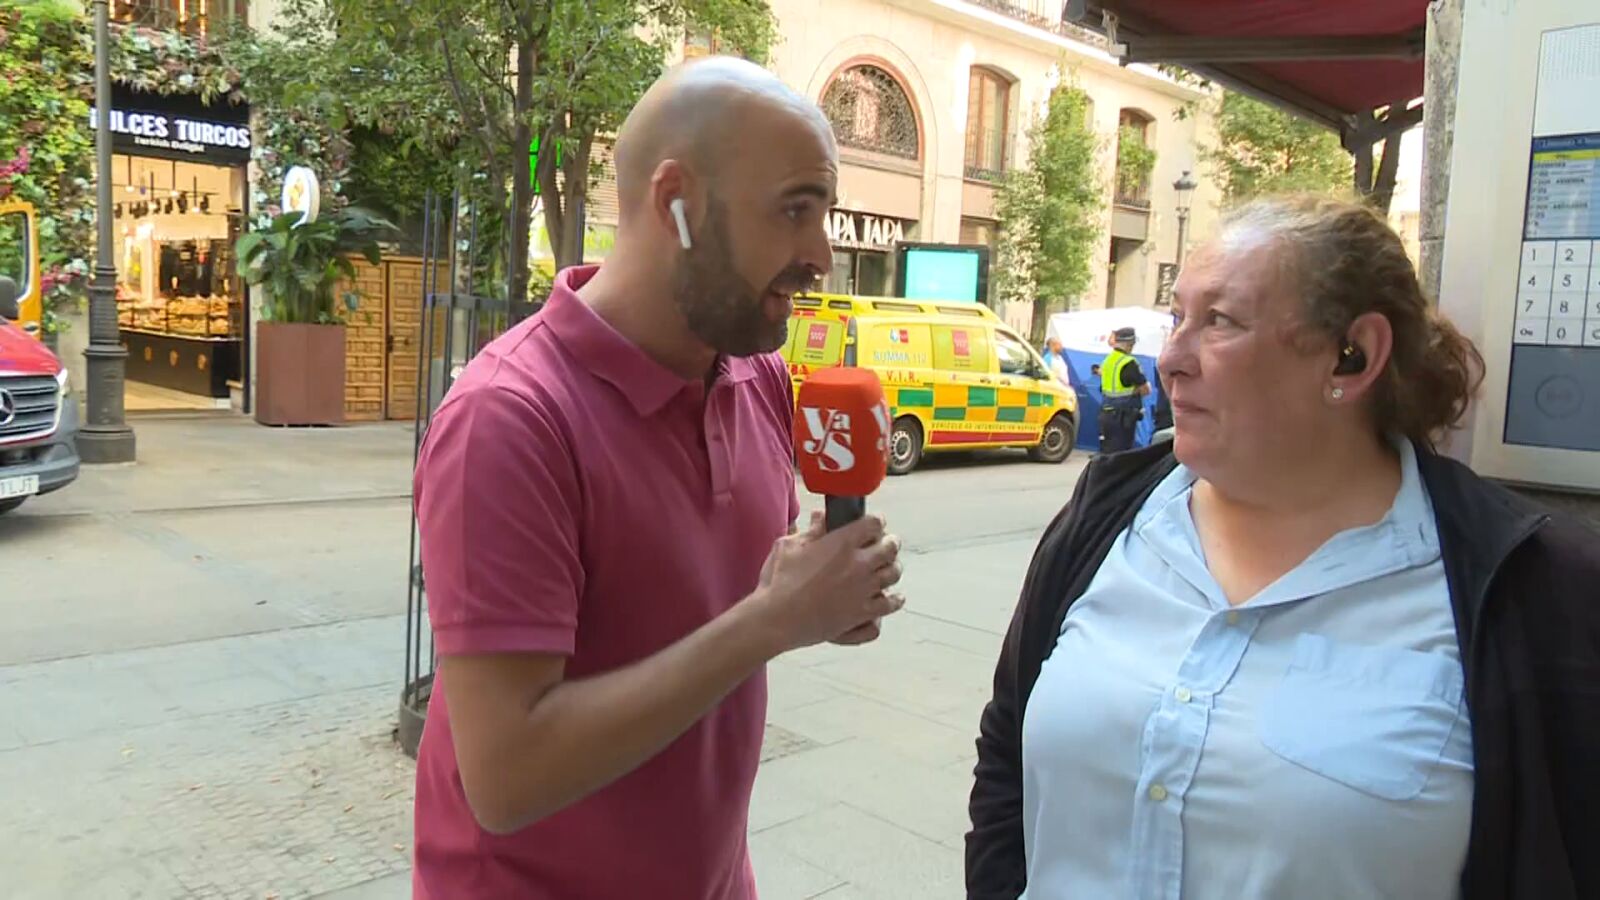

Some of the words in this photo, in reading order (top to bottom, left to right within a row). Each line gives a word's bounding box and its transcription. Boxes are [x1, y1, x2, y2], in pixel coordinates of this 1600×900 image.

[174, 119, 250, 148] TURCOS
[823, 210, 857, 242] APA
[862, 214, 904, 247] TAPA
[1532, 248, 1536, 261] 1
[1565, 248, 1574, 261] 2
[1528, 275, 1536, 287] 4
[1562, 274, 1571, 287] 5
[1526, 300, 1533, 312] 7
[1560, 301, 1568, 313] 8
